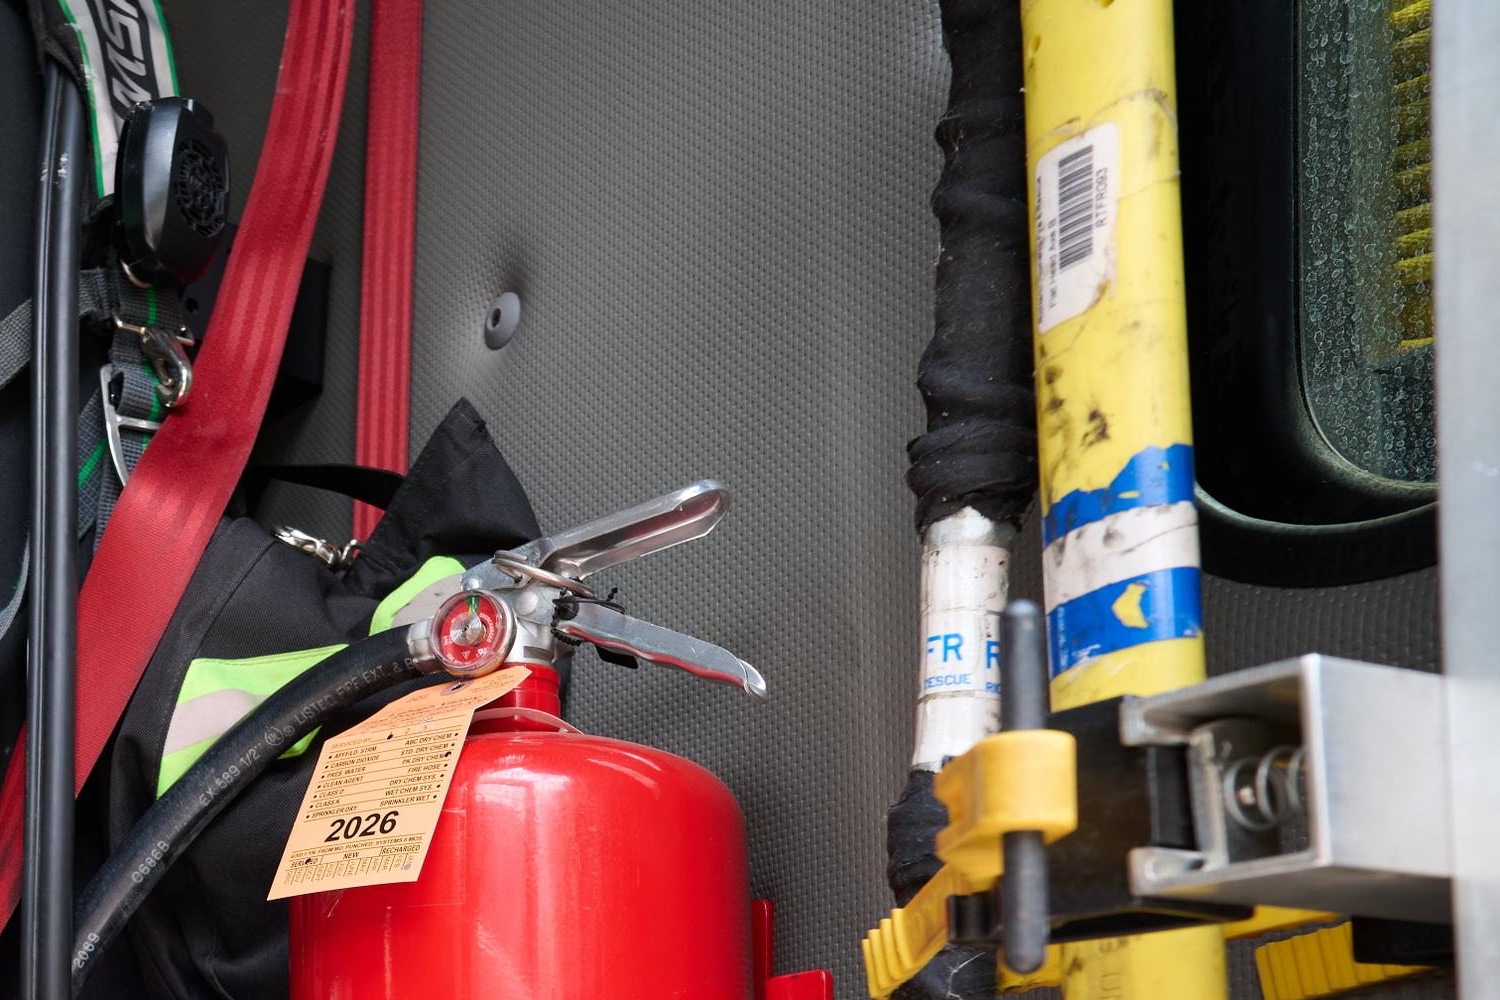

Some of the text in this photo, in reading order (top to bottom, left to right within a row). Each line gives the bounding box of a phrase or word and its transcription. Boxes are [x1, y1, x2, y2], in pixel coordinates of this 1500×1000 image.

[419, 736, 432, 744] DRY
[433, 733, 452, 742] CHEM
[415, 746, 429, 754] DRY
[429, 743, 449, 751] CHEM
[331, 754, 380, 769] CARBON DIOXIDE
[344, 766, 366, 775] WATER
[423, 763, 441, 771] HOSE
[322, 776, 364, 788] CLEAN AGENT
[389, 778, 403, 786] DRY
[404, 776, 423, 784] CHEM
[319, 790, 339, 799] CLASS
[399, 786, 419, 794] CHEM
[315, 800, 335, 808] CLASS
[380, 794, 431, 807] SPRINKLER WET
[72, 933, 100, 968] 2069
[215, 765, 241, 789] 589
[294, 694, 335, 725] LISTED
[336, 676, 362, 699] FIRE
[393, 662, 402, 673] &
[324, 811, 399, 843] 2026
[381, 845, 421, 854] RECHARGED
[342, 852, 360, 860] NEW
[291, 858, 319, 868] SERVED
